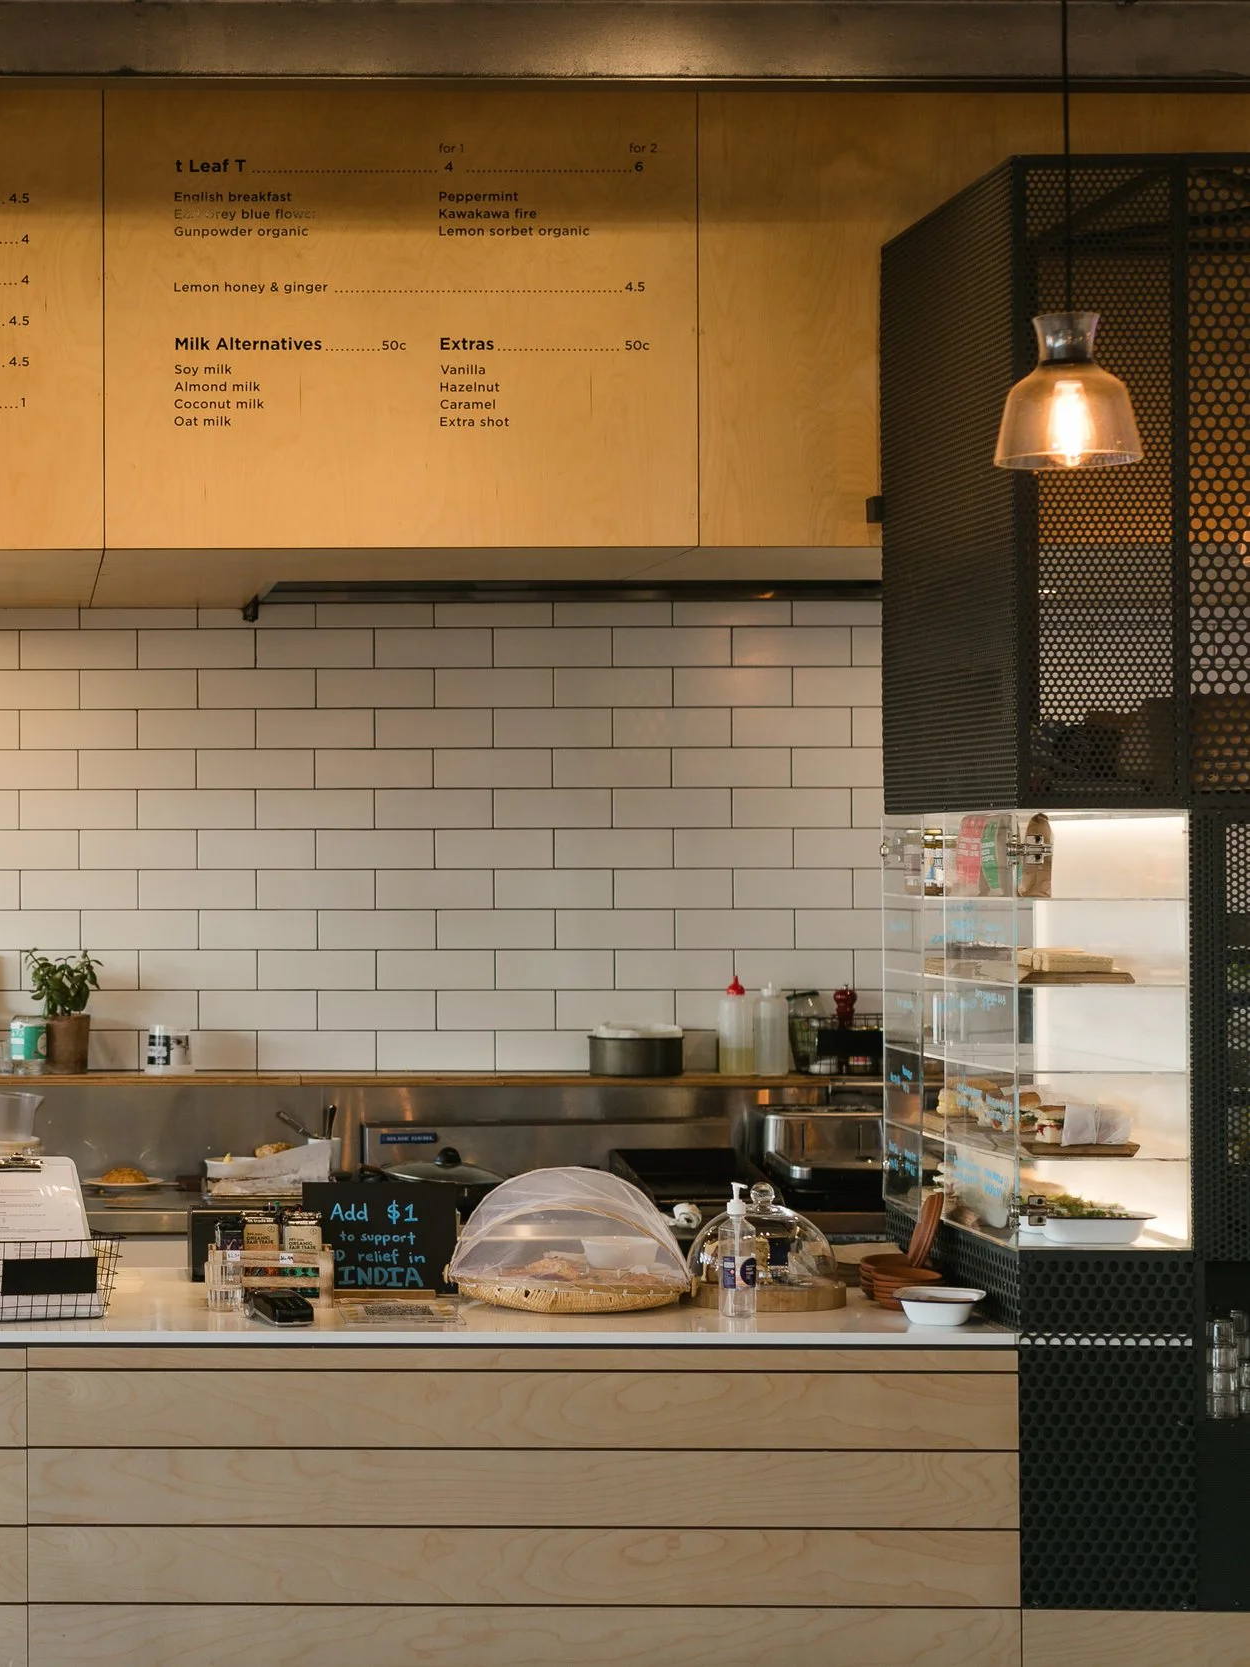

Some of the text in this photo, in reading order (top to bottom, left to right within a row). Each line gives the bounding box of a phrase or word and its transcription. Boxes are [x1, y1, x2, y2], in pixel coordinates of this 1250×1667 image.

[439, 143, 464, 153] for 1
[629, 143, 657, 153] for 2
[189, 159, 229, 172] Leaf
[235, 159, 246, 172] T
[444, 162, 453, 172] 4
[634, 162, 643, 172] 6
[9, 193, 30, 203] 4.5
[174, 192, 292, 203] English breakfast
[439, 191, 518, 203] Peppermint
[242, 209, 270, 219] blue
[439, 208, 537, 219] Kawakawa fire
[174, 226, 308, 238] Gunpowder organic
[439, 225, 590, 238] Lemon sorbet organic
[21, 234, 29, 244] 4
[21, 275, 29, 285] 4
[173, 282, 645, 294] Lemon honey & ginger 4.5
[9, 316, 30, 326] 4.5
[175, 337, 406, 350] Milk Alternatives 50c
[440, 337, 650, 350] Extras 50c
[9, 357, 30, 366] 4.5
[174, 364, 232, 376] Soy milk
[441, 364, 486, 375] Vanilla
[174, 381, 260, 392] Almond milk
[440, 382, 500, 392] Hazelnut
[21, 398, 26, 407] 1
[174, 399, 264, 409] Coconut milk
[440, 399, 496, 410] Caramel
[174, 416, 231, 426] Oat milk
[440, 416, 510, 427] Extra shot
[330, 1199, 418, 1224] Add $1
[339, 1230, 416, 1246] to support
[358, 1248, 399, 1265] relief
[409, 1251, 426, 1263] in
[338, 1265, 424, 1287] INDIA
